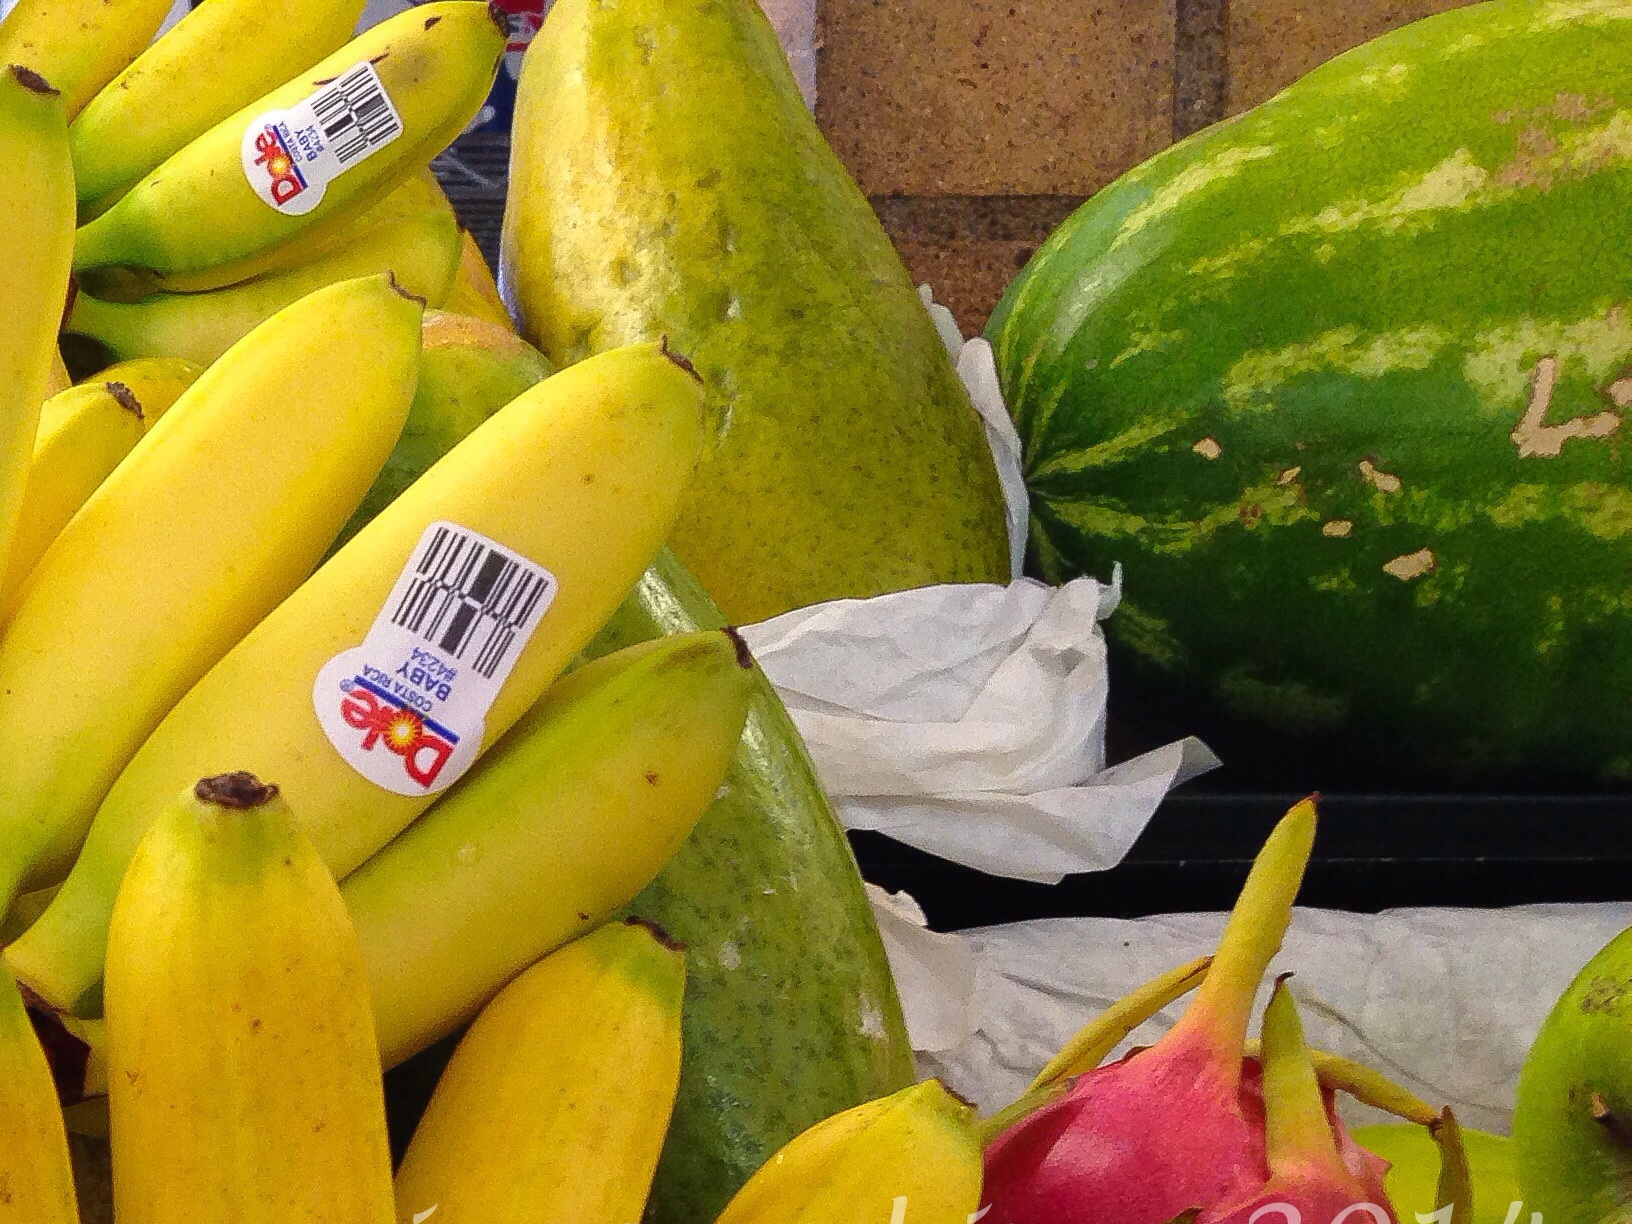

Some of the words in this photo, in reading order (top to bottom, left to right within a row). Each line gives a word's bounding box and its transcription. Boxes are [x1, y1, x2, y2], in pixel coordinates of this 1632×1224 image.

[294, 129, 317, 161] BABY
[254, 131, 305, 206] Dole
[362, 664, 391, 690] RICA
[410, 646, 458, 681] #4234
[387, 681, 432, 712] COSTA
[396, 661, 452, 702] BABY
[340, 688, 454, 788] Dole
